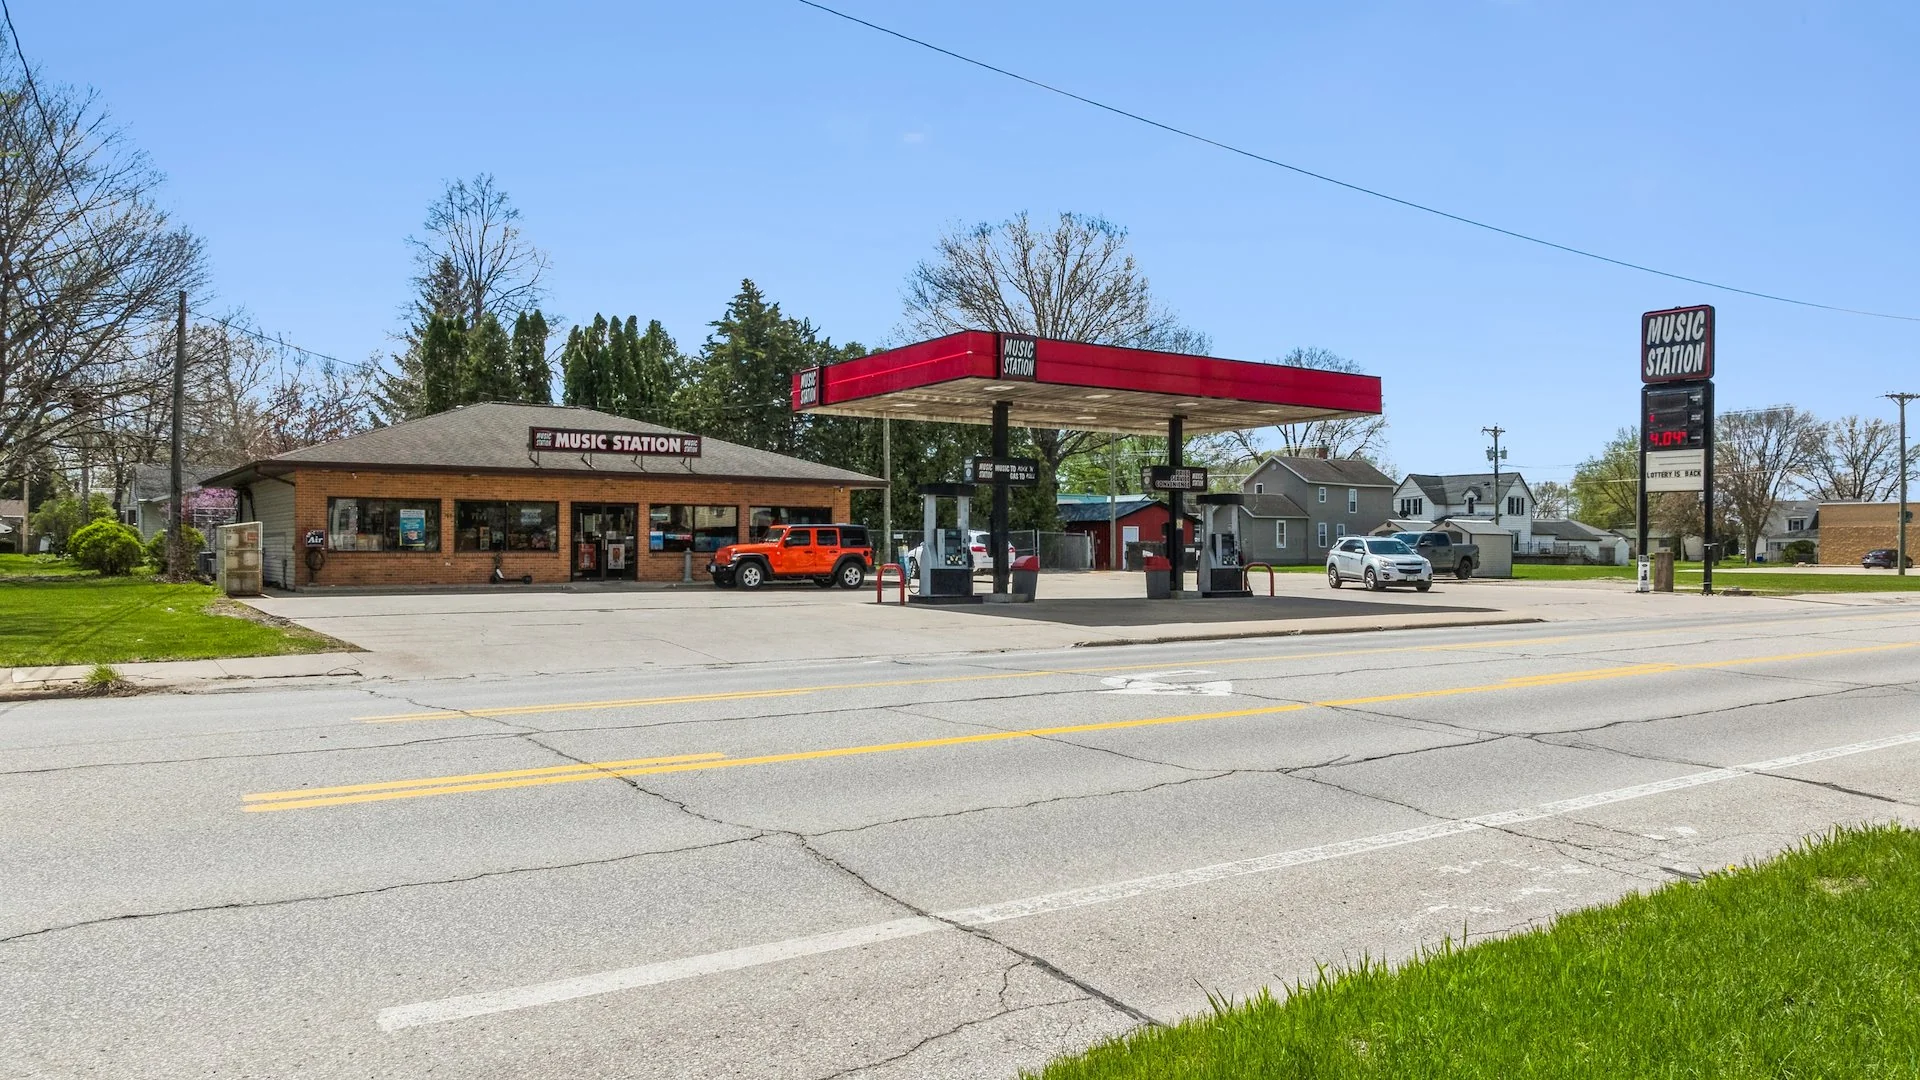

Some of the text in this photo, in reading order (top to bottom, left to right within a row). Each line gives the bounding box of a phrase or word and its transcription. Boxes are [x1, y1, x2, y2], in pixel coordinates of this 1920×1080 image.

[1646, 310, 1705, 345] MUSIC
[1004, 339, 1034, 358] MUSIC
[1003, 357, 1034, 376] STATION
[1646, 342, 1705, 377] STATION
[801, 371, 816, 389] MUSIC
[555, 432, 681, 453] MUSIC STATION
[1646, 469, 1702, 479] LOTTERY IS BACK
[308, 536, 324, 544] Air
